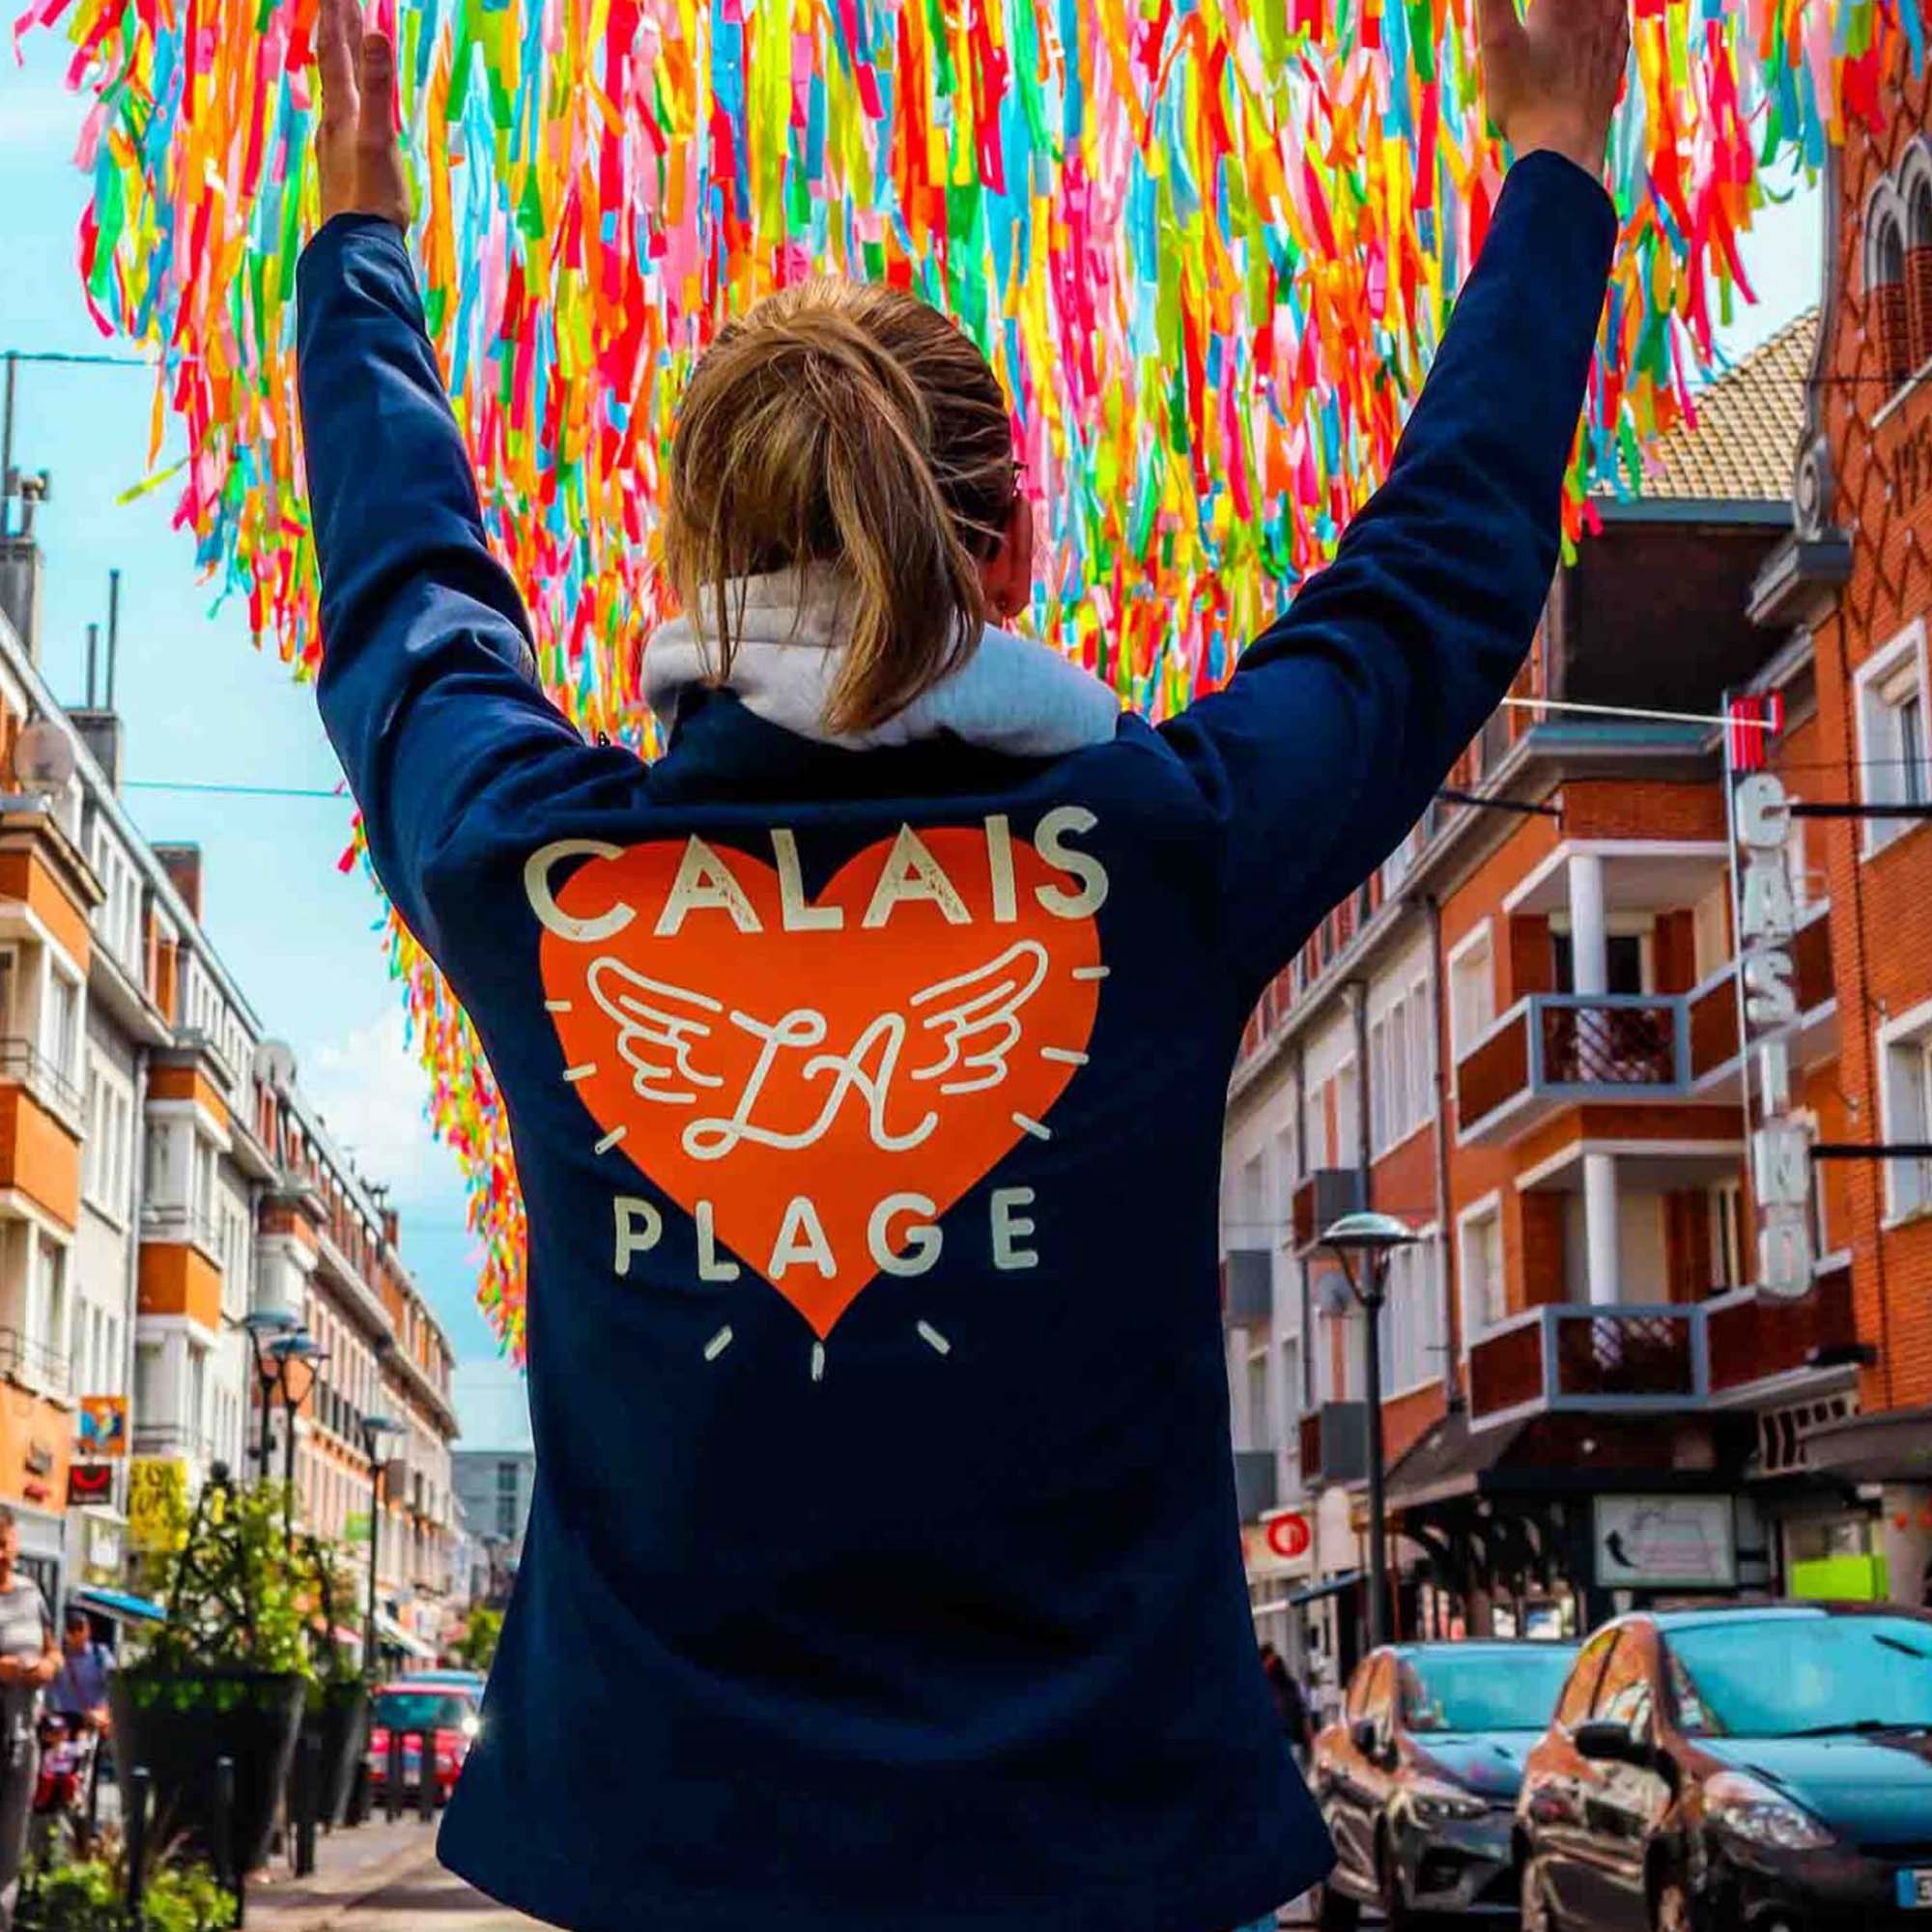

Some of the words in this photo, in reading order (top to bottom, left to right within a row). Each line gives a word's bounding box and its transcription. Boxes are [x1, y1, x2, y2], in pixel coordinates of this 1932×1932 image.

[525, 807, 1109, 942] CALAIS
[682, 1009, 938, 1160] LA
[1736, 773, 1812, 1298] CASINO
[613, 1188, 1038, 1281] PLAGE
